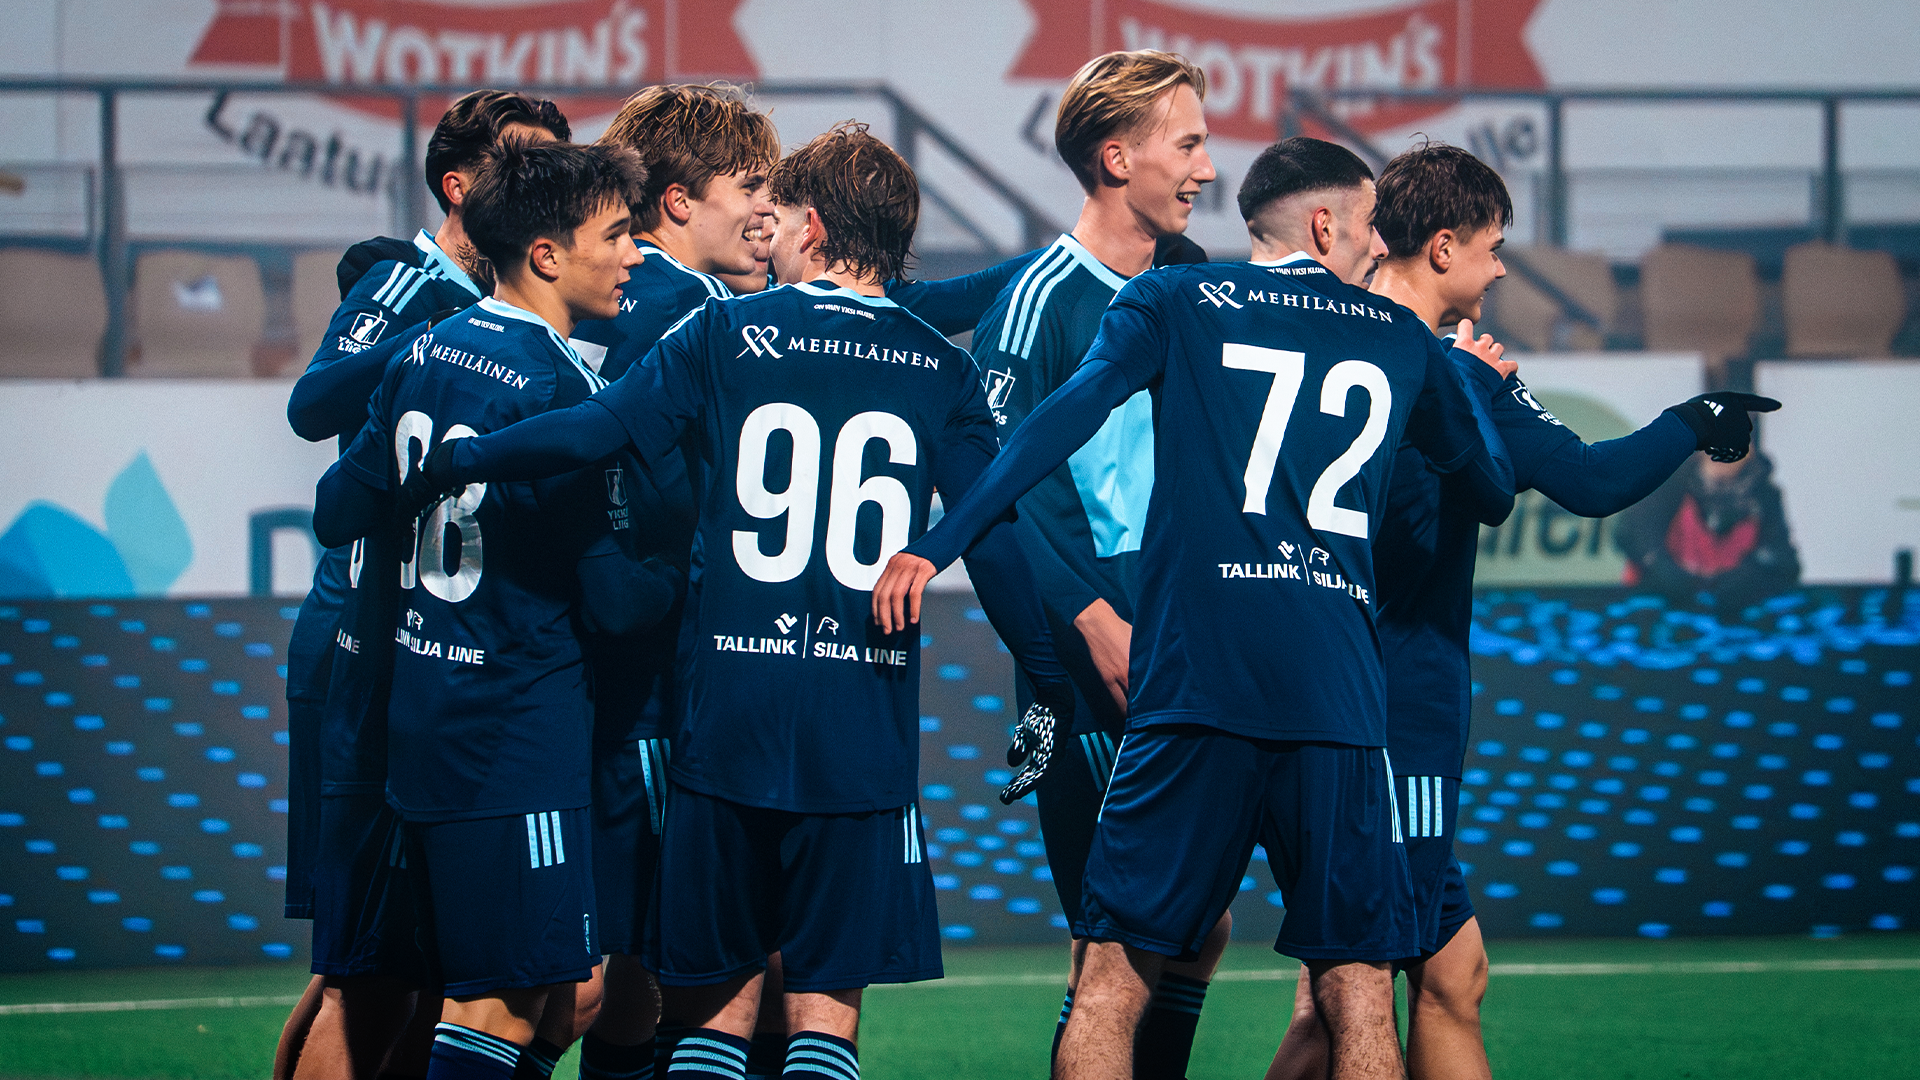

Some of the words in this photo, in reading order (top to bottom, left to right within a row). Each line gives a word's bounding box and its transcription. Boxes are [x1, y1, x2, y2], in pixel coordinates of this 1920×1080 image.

[1248, 289, 1393, 324] MEHILÄINEN
[430, 344, 530, 391] MEHILÄINEN
[787, 336, 940, 371] MEHILÄINEN
[1221, 342, 1392, 539] 72
[732, 402, 917, 592] 96
[1218, 563, 1301, 580] TALLINK
[447, 645, 485, 665] LINE
[713, 634, 798, 656] TALLINK
[865, 647, 907, 666] LINE
